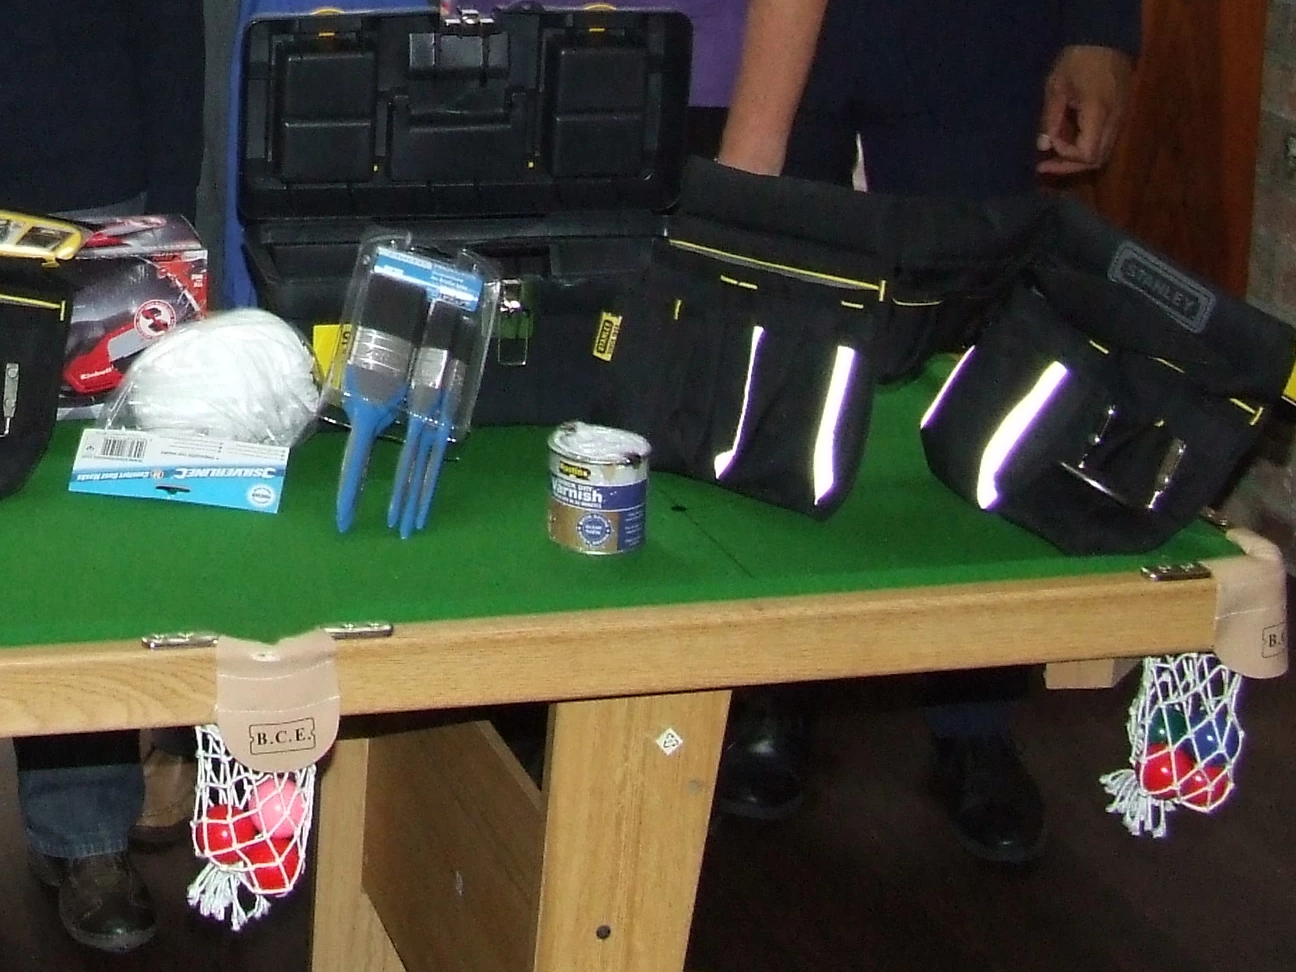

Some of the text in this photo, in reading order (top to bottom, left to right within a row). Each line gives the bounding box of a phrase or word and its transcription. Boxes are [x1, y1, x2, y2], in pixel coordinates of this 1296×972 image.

[1124, 262, 1196, 311] STANLEY
[180, 468, 269, 478] SILVERLINE
[552, 477, 603, 503] Varnish
[257, 727, 312, 746] B.C.E.
